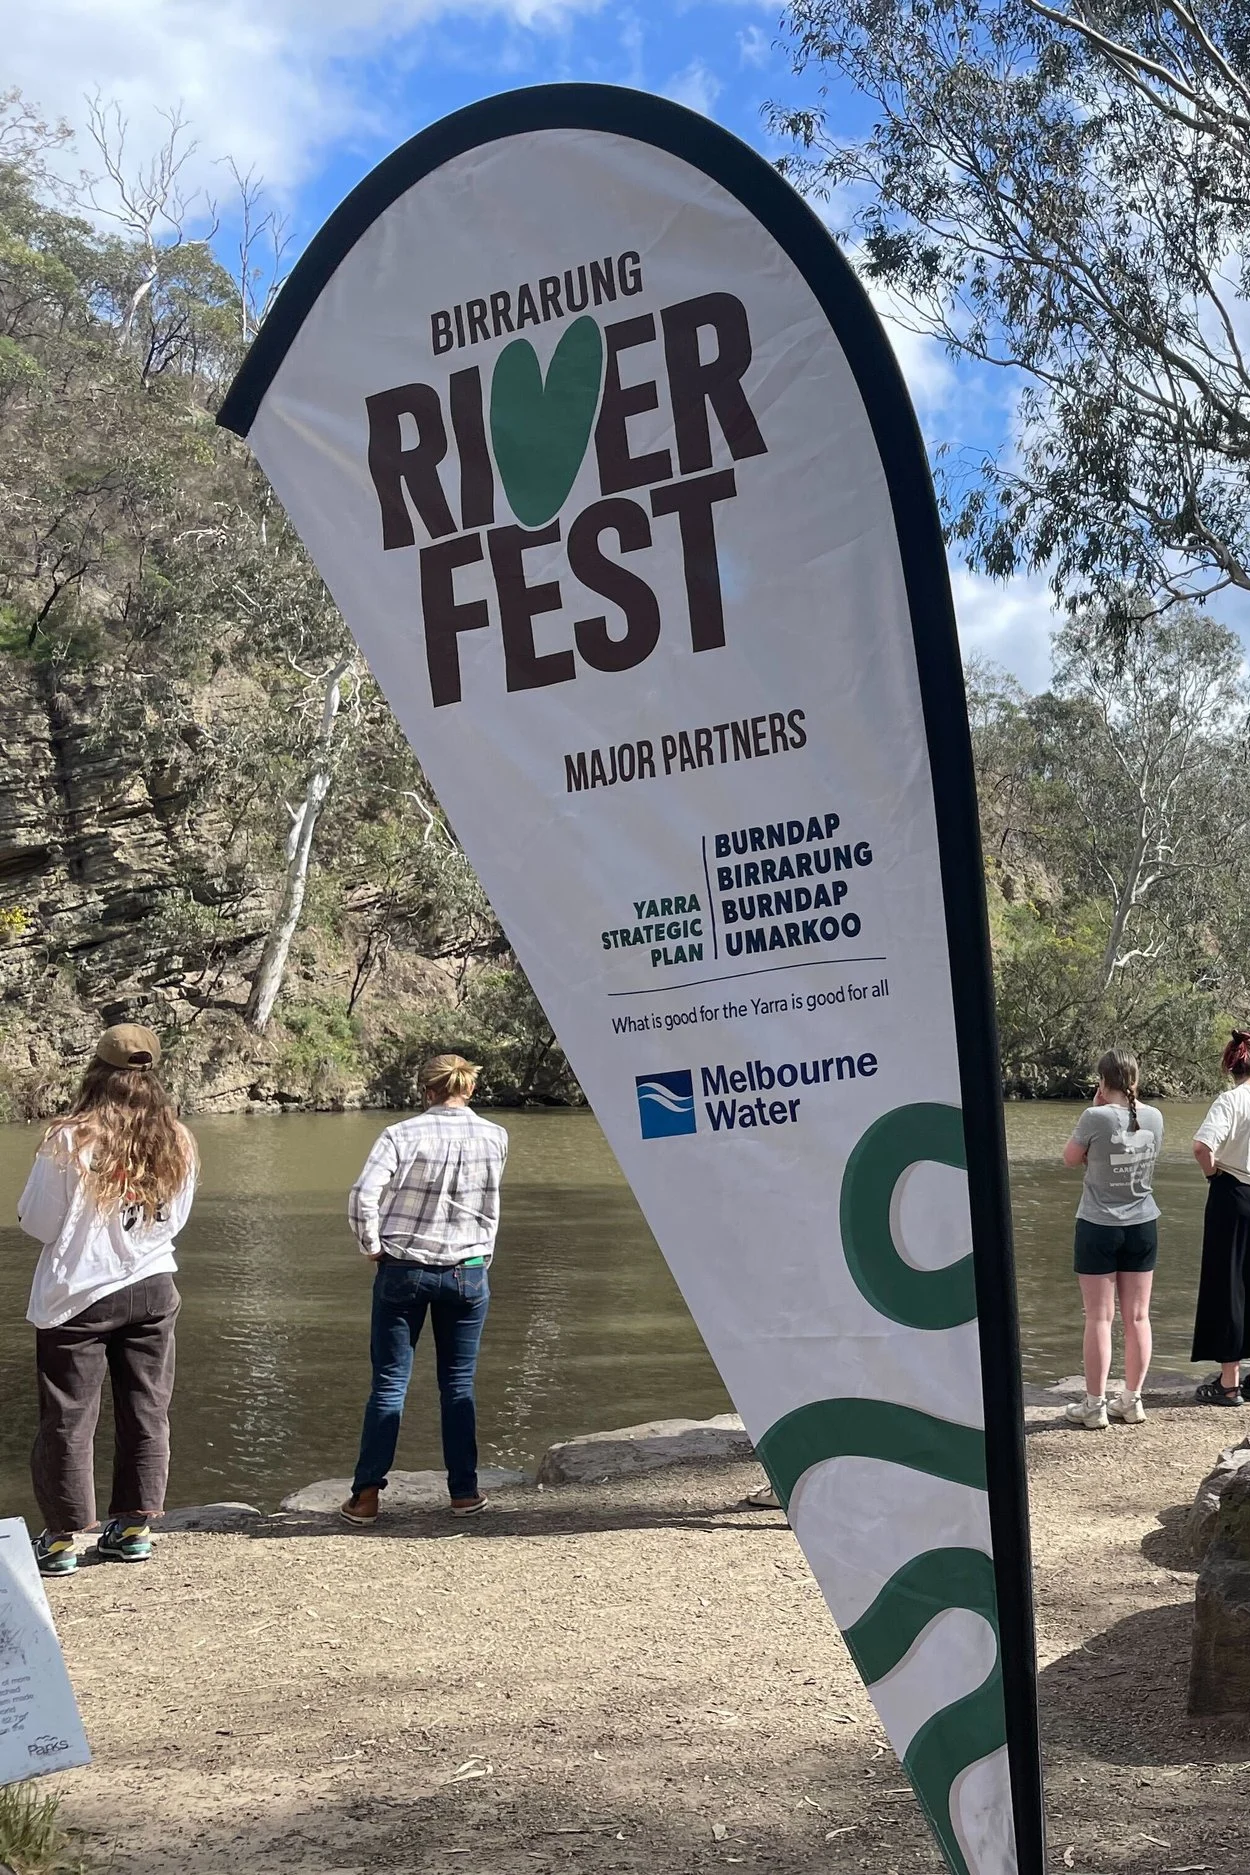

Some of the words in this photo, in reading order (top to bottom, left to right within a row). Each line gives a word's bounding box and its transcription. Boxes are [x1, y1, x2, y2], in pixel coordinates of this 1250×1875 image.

[431, 251, 643, 355] BIRRARUNG
[419, 468, 737, 708] FEST
[565, 739, 656, 792] MAJOR
[661, 709, 807, 774] PARTNERS
[715, 813, 840, 858] BURNDAP
[717, 842, 873, 891] BIRRARUNG
[633, 894, 701, 919] YARRA
[722, 880, 848, 924] BURNDAP
[601, 918, 703, 949] STRATEGIC
[651, 943, 703, 967] PLAN
[726, 913, 861, 956] UMARKOO
[612, 1015, 650, 1034] What
[652, 1013, 662, 1029] is
[664, 1007, 698, 1031] good
[700, 1005, 719, 1022] for
[723, 1002, 748, 1019] the
[750, 998, 788, 1015] Yarra
[791, 993, 803, 1010] is
[806, 986, 845, 1011] good
[848, 984, 868, 1001] for
[872, 979, 889, 999] all
[701, 1051, 878, 1097] Melbourne
[705, 1097, 800, 1131] Water
